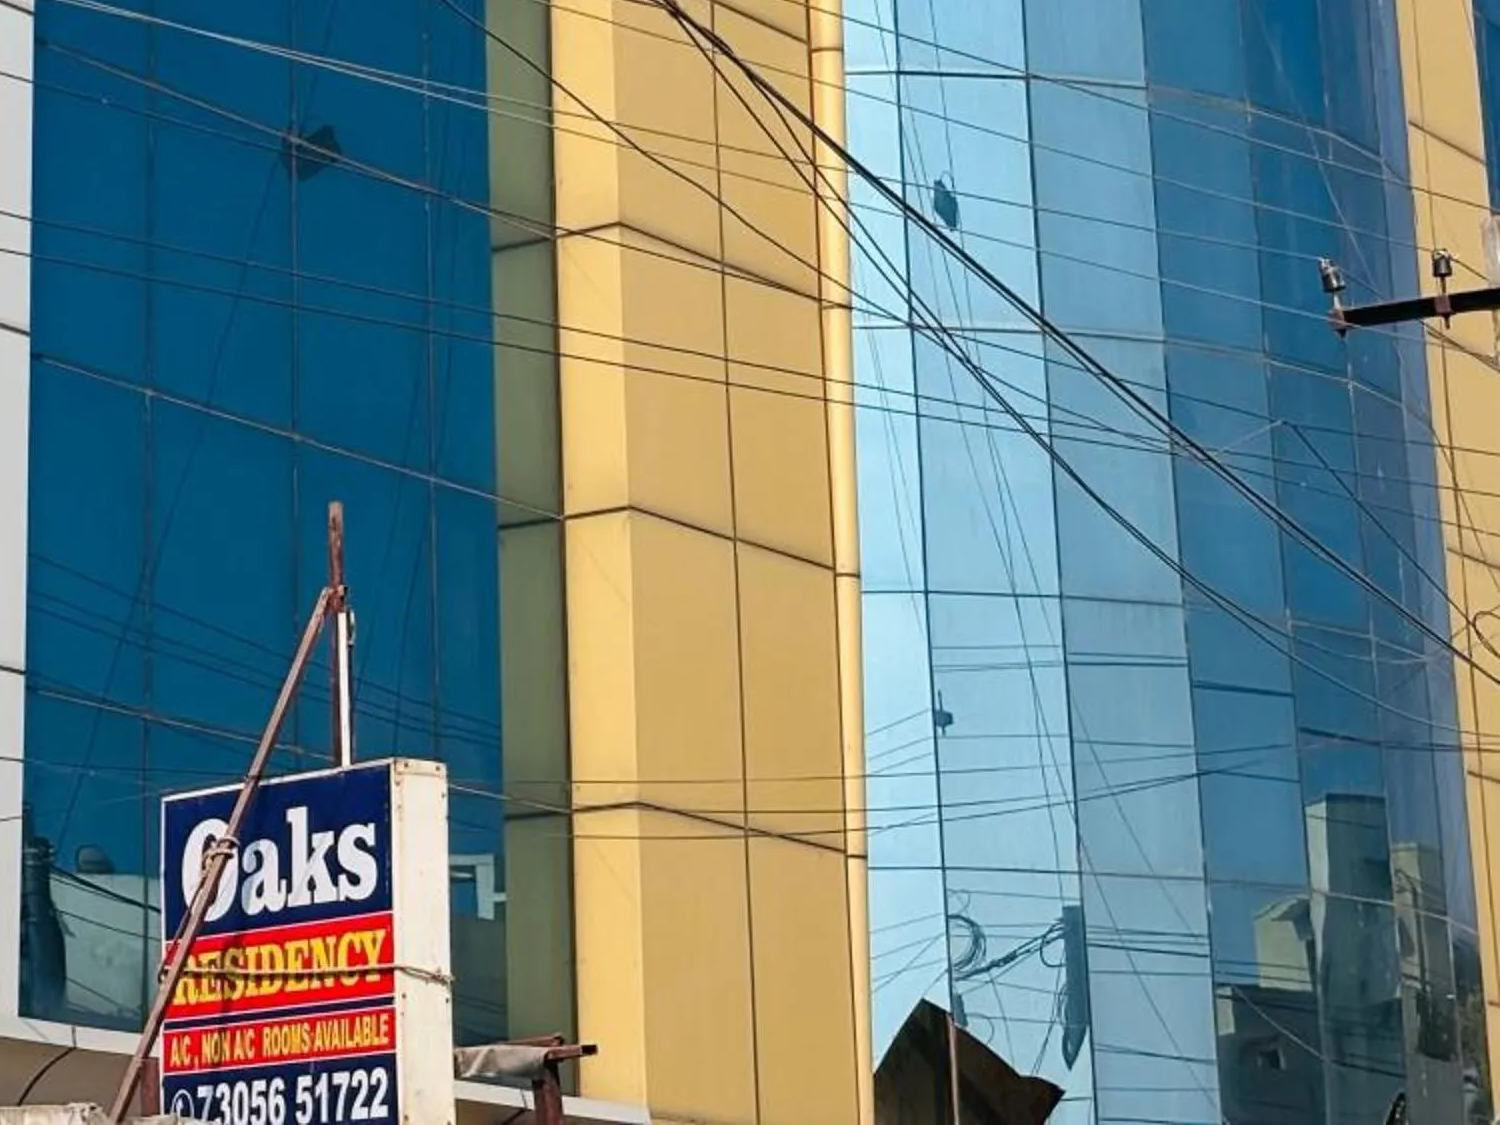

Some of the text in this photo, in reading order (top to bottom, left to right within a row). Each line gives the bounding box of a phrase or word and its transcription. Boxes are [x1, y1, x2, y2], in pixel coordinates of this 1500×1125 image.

[181, 806, 378, 922] Oaks
[172, 928, 387, 1006] RESIDENCY
[202, 1030, 231, 1065] NON
[263, 1021, 311, 1058] ROOMS
[313, 1012, 390, 1053] AVAILABLE
[197, 1066, 389, 1125] 73056 51722
